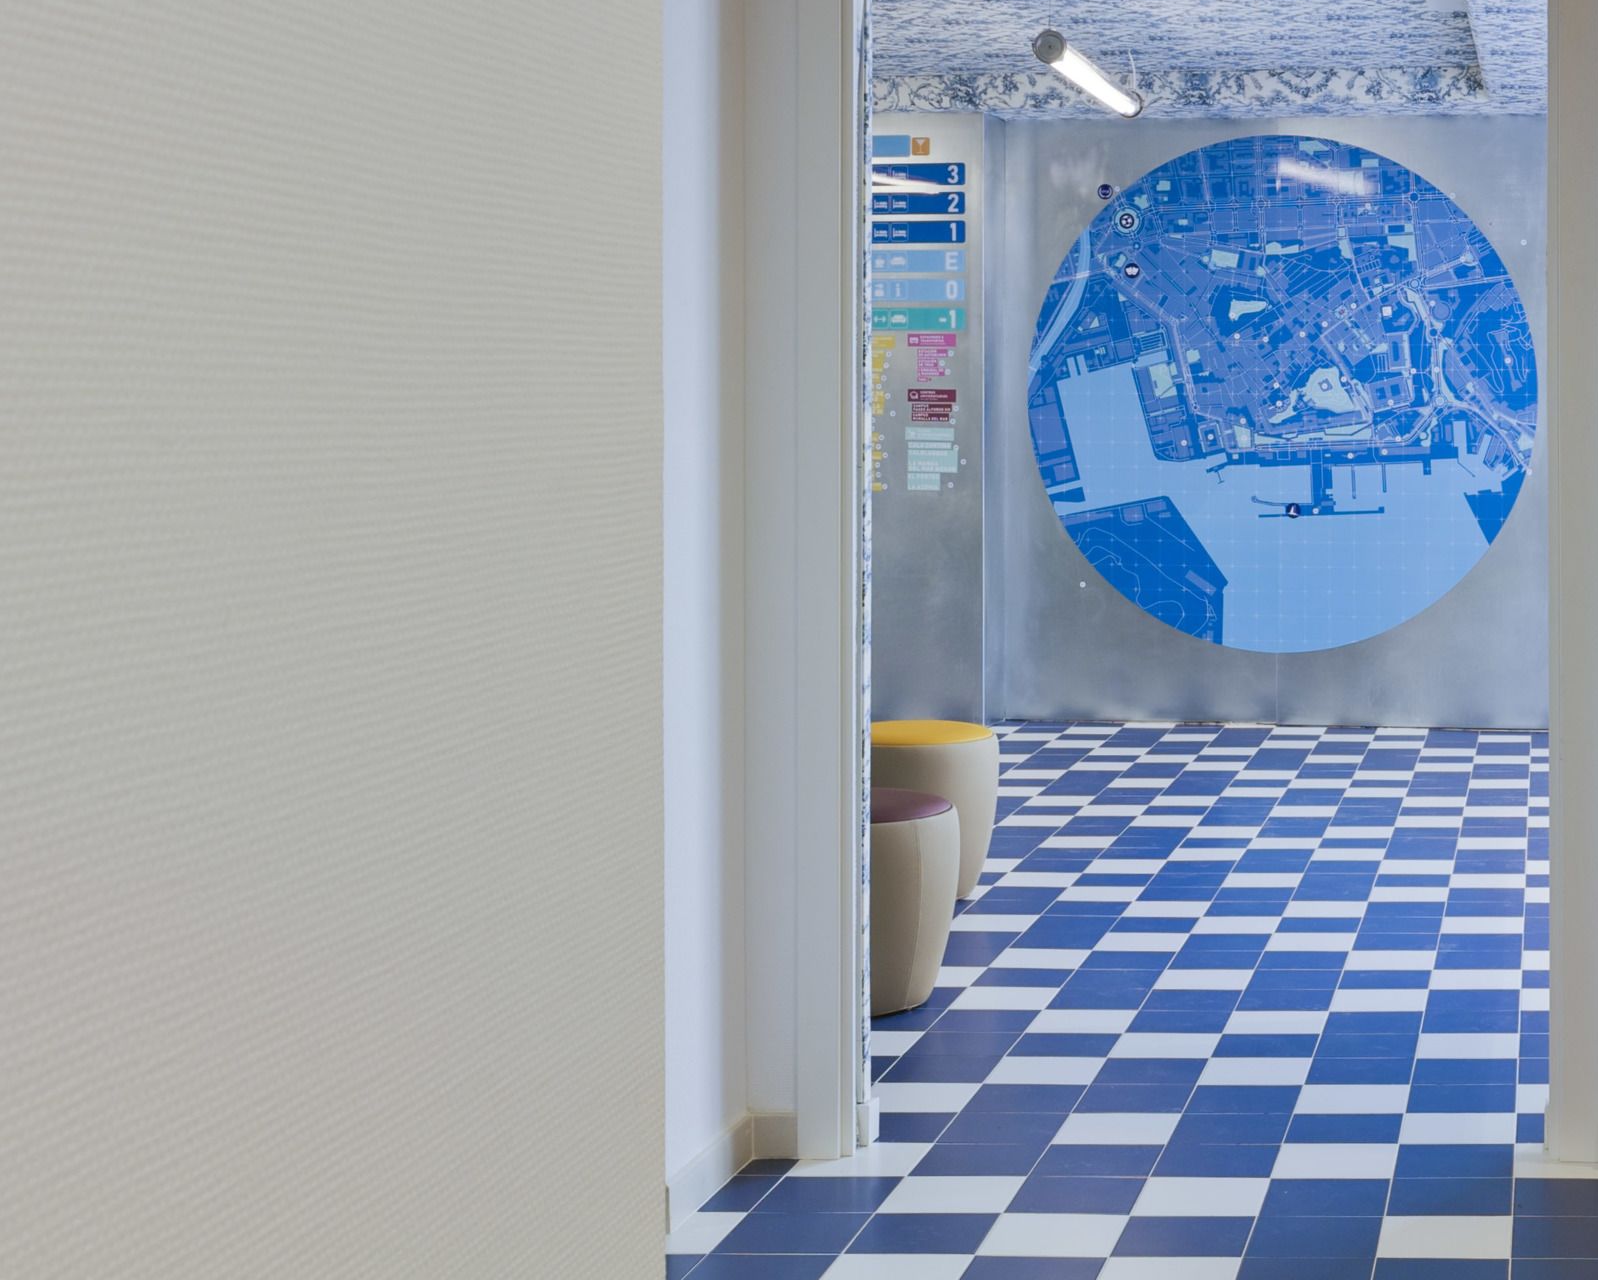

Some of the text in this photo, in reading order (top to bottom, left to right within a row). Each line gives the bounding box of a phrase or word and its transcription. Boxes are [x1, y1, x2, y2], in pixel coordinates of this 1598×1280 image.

[947, 164, 960, 184] 3
[947, 193, 960, 213] 2
[949, 222, 957, 242] 1
[945, 251, 959, 271] E
[938, 309, 957, 329] -1
